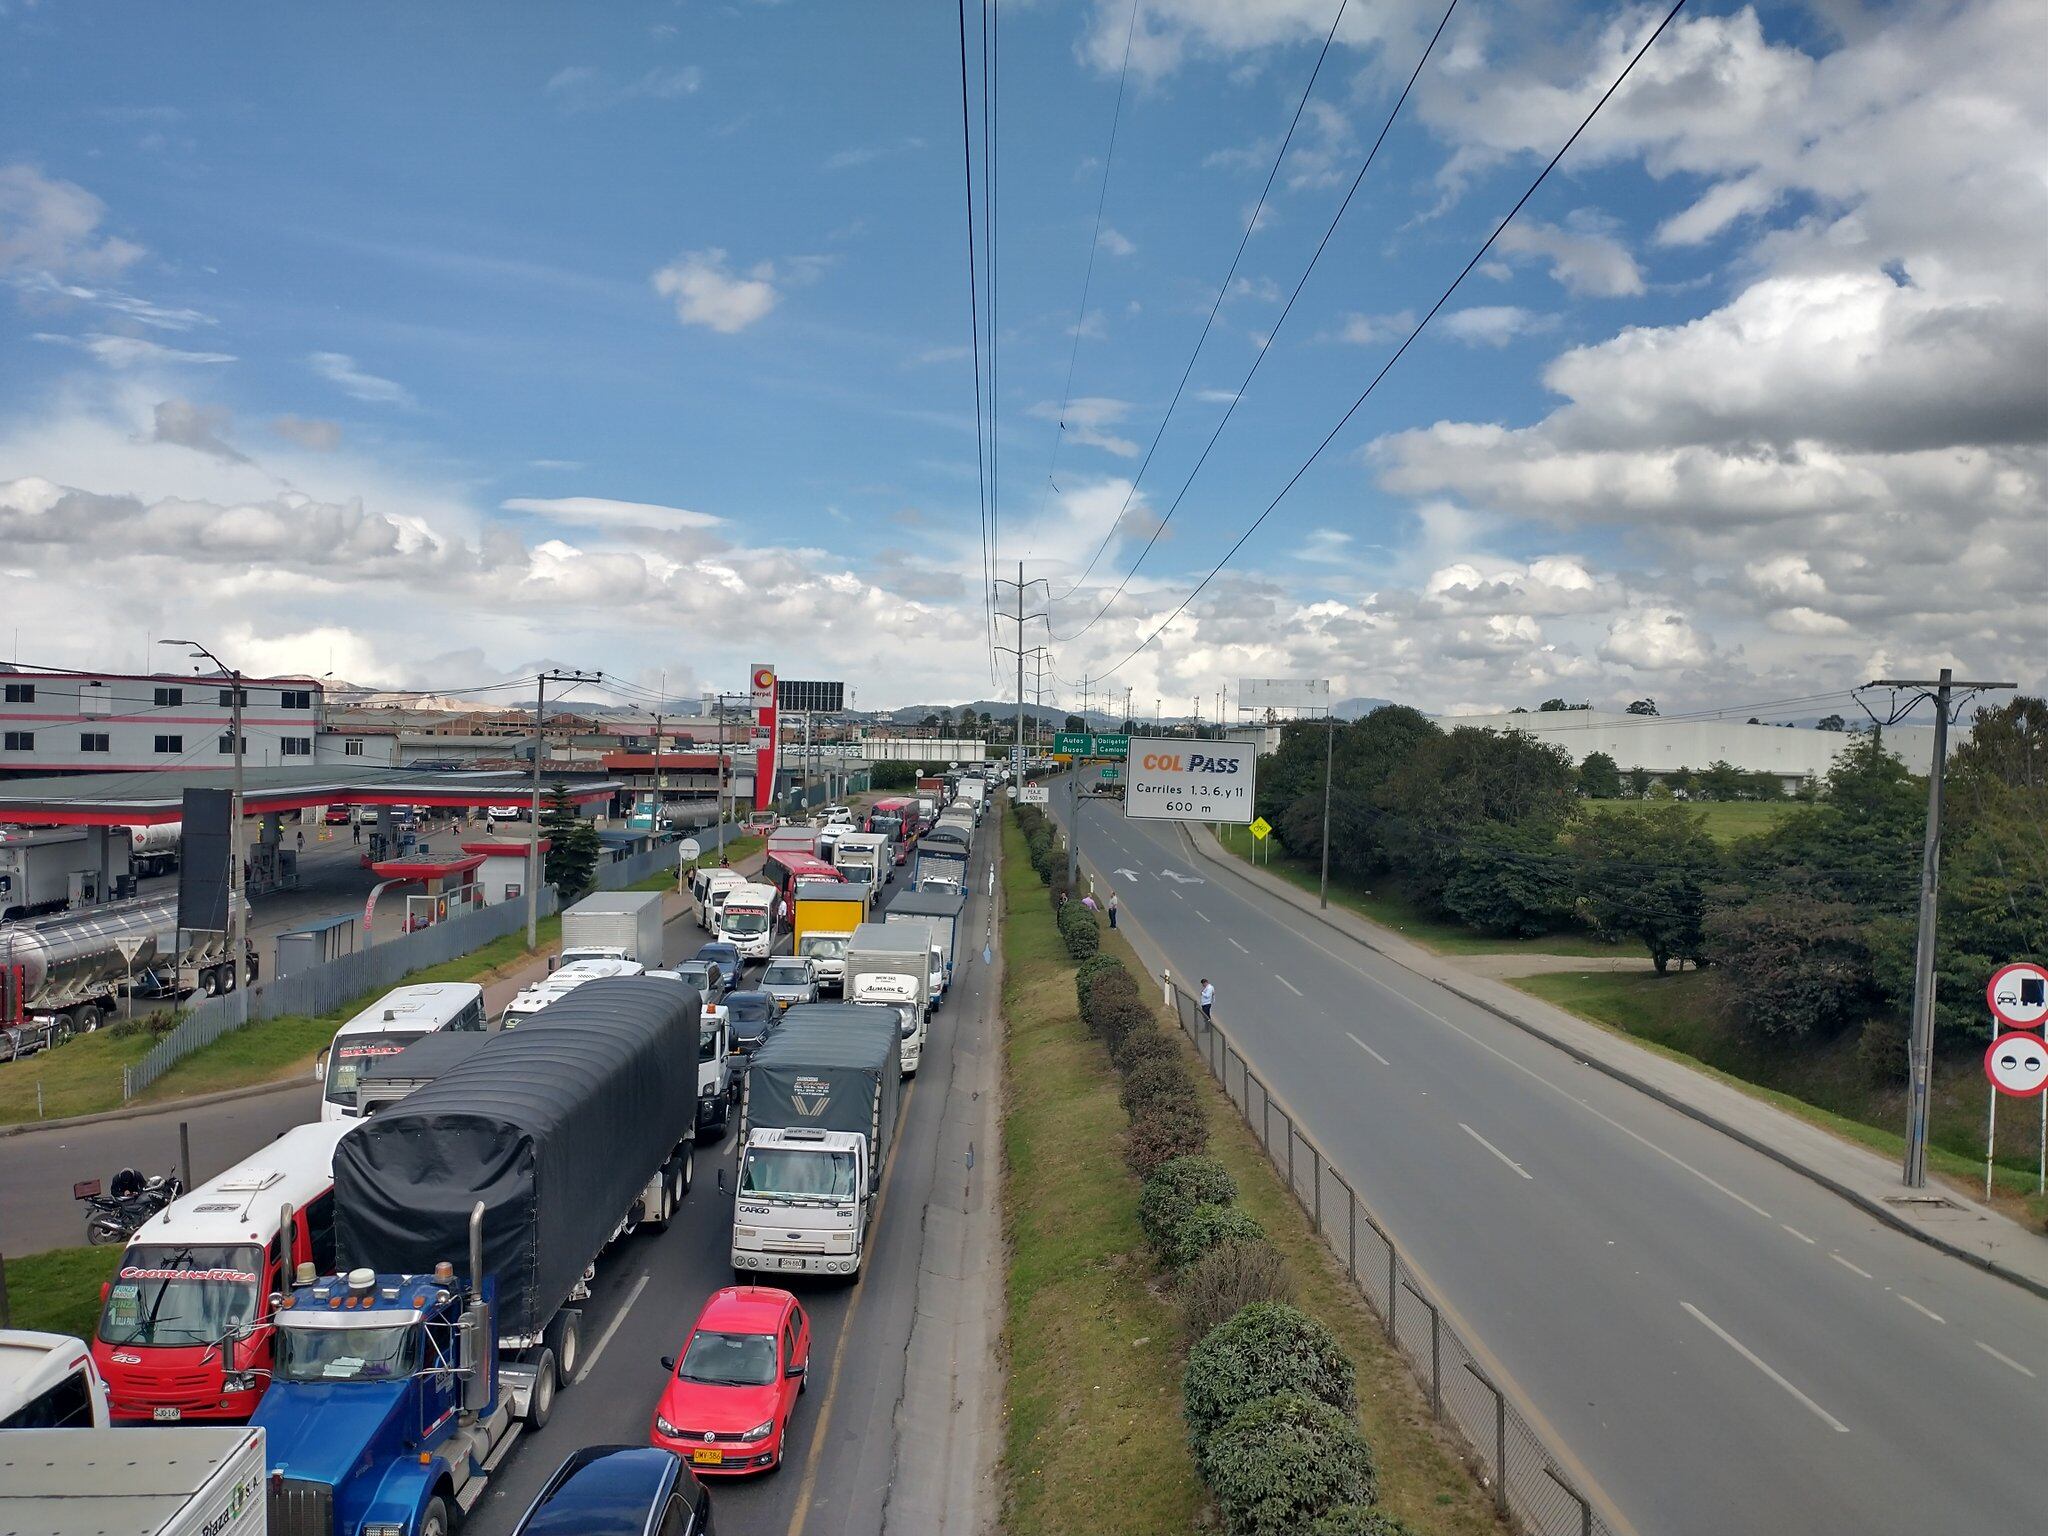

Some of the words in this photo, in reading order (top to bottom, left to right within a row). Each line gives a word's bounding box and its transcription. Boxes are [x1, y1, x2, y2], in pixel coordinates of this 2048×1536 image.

[1143, 754, 1184, 771] COL
[1187, 754, 1240, 774] PASS
[1136, 783, 1182, 794] Carriles
[1166, 801, 1193, 812] 600
[1201, 805, 1211, 813] m
[739, 1205, 770, 1214] CARGO
